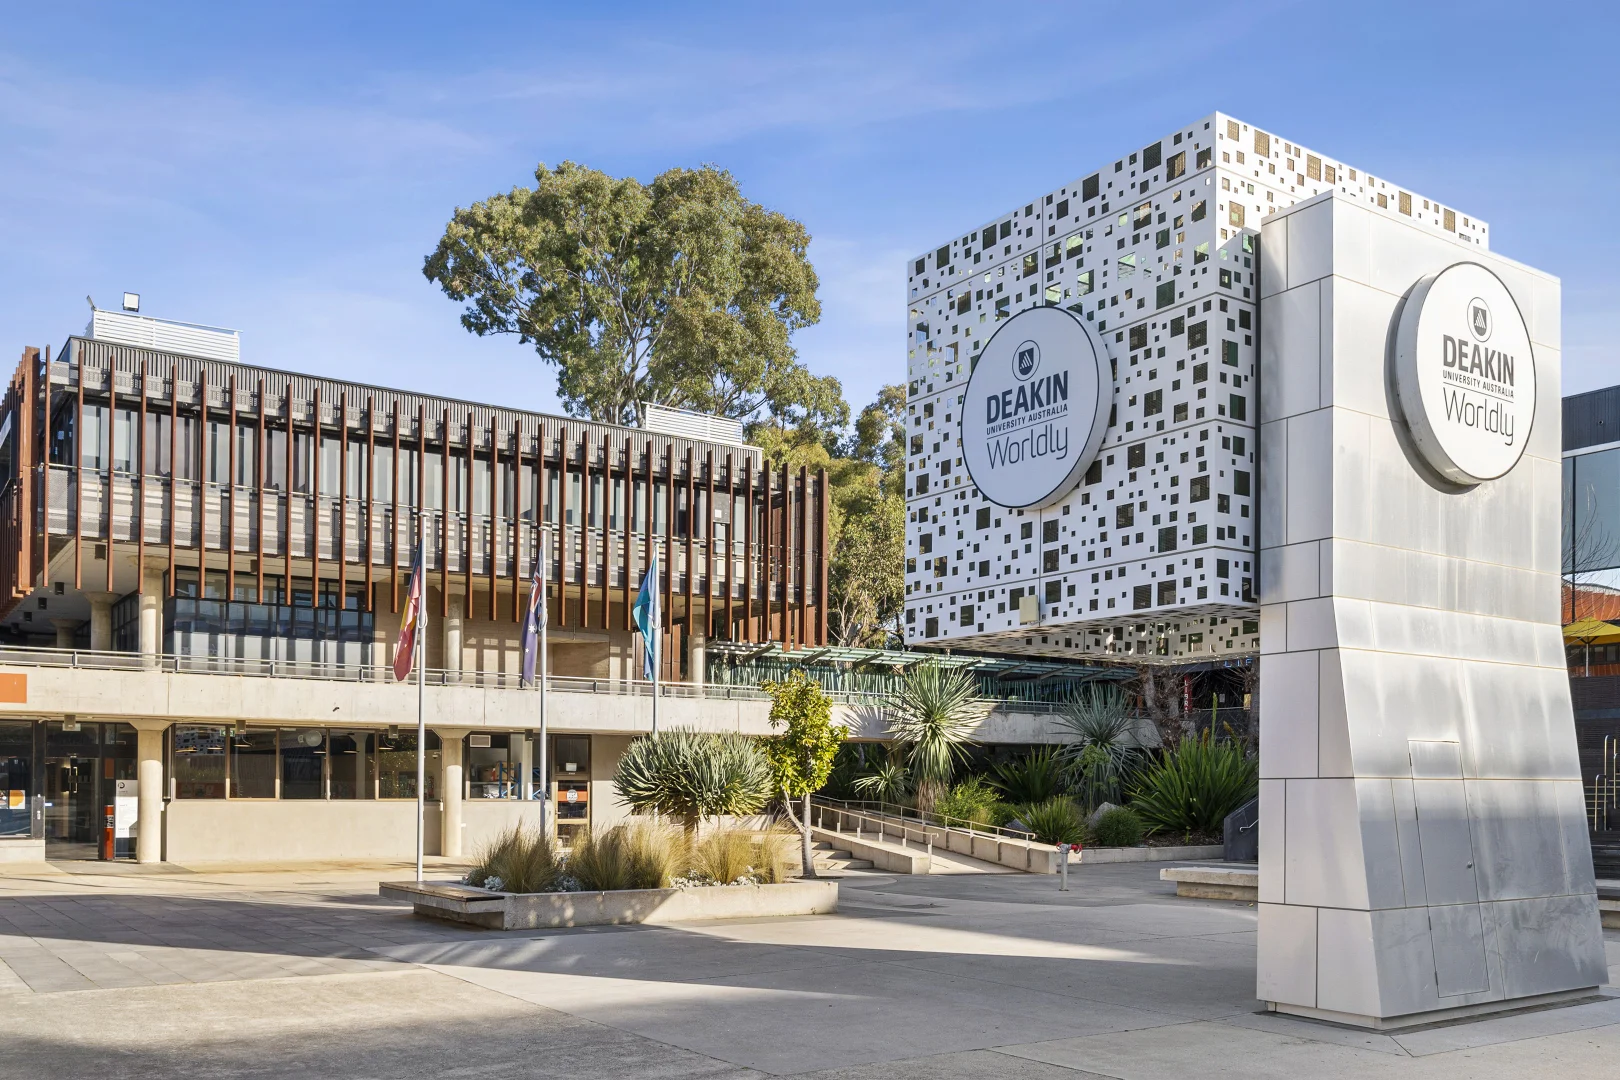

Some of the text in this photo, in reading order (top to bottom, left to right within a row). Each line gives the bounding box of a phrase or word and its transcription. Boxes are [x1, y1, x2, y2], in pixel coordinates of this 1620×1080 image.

[1443, 334, 1514, 386] DEAKIN
[1443, 370, 1514, 398] UNIVERSITY AUSTRALIA
[986, 404, 1068, 436] UNIVERSITY AUSTRALIA
[987, 370, 1068, 424] DEAKIN
[1443, 387, 1514, 446] Worldly
[986, 424, 1068, 470] Worldly
